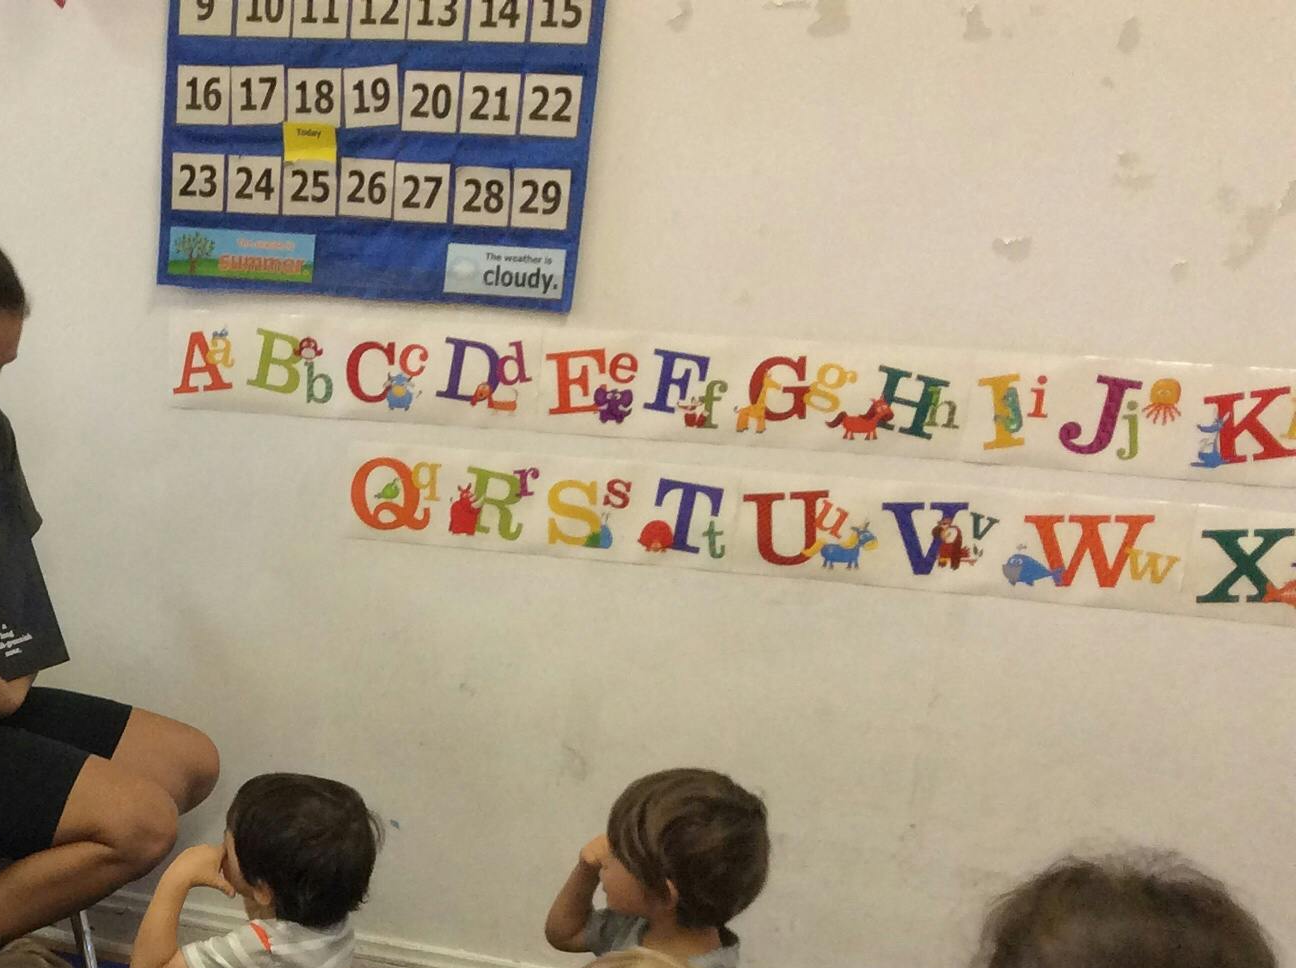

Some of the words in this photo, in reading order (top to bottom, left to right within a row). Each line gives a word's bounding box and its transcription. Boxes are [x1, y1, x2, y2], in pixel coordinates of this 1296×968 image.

[196, 0, 215, 20] 9
[246, 0, 284, 23] 10
[301, 0, 339, 24] 11
[359, 0, 399, 26] 12
[417, 0, 457, 27] 13
[479, 0, 519, 28] 14
[540, 0, 582, 29] 15
[185, 77, 222, 111] 16
[240, 77, 277, 112] 17
[295, 79, 334, 114] 18
[353, 77, 390, 114] 19
[410, 83, 451, 119] 20
[469, 85, 510, 121] 21
[528, 86, 572, 122] 22
[296, 128, 321, 139] Today
[179, 164, 217, 198] 23
[234, 167, 274, 200] 24
[291, 170, 330, 203] 25
[346, 171, 387, 205] 26
[402, 175, 442, 209] 27
[463, 179, 503, 213] 28
[519, 179, 561, 214] 29
[486, 253, 502, 262] The
[504, 254, 542, 264] weather
[483, 265, 558, 294] cloudy.
